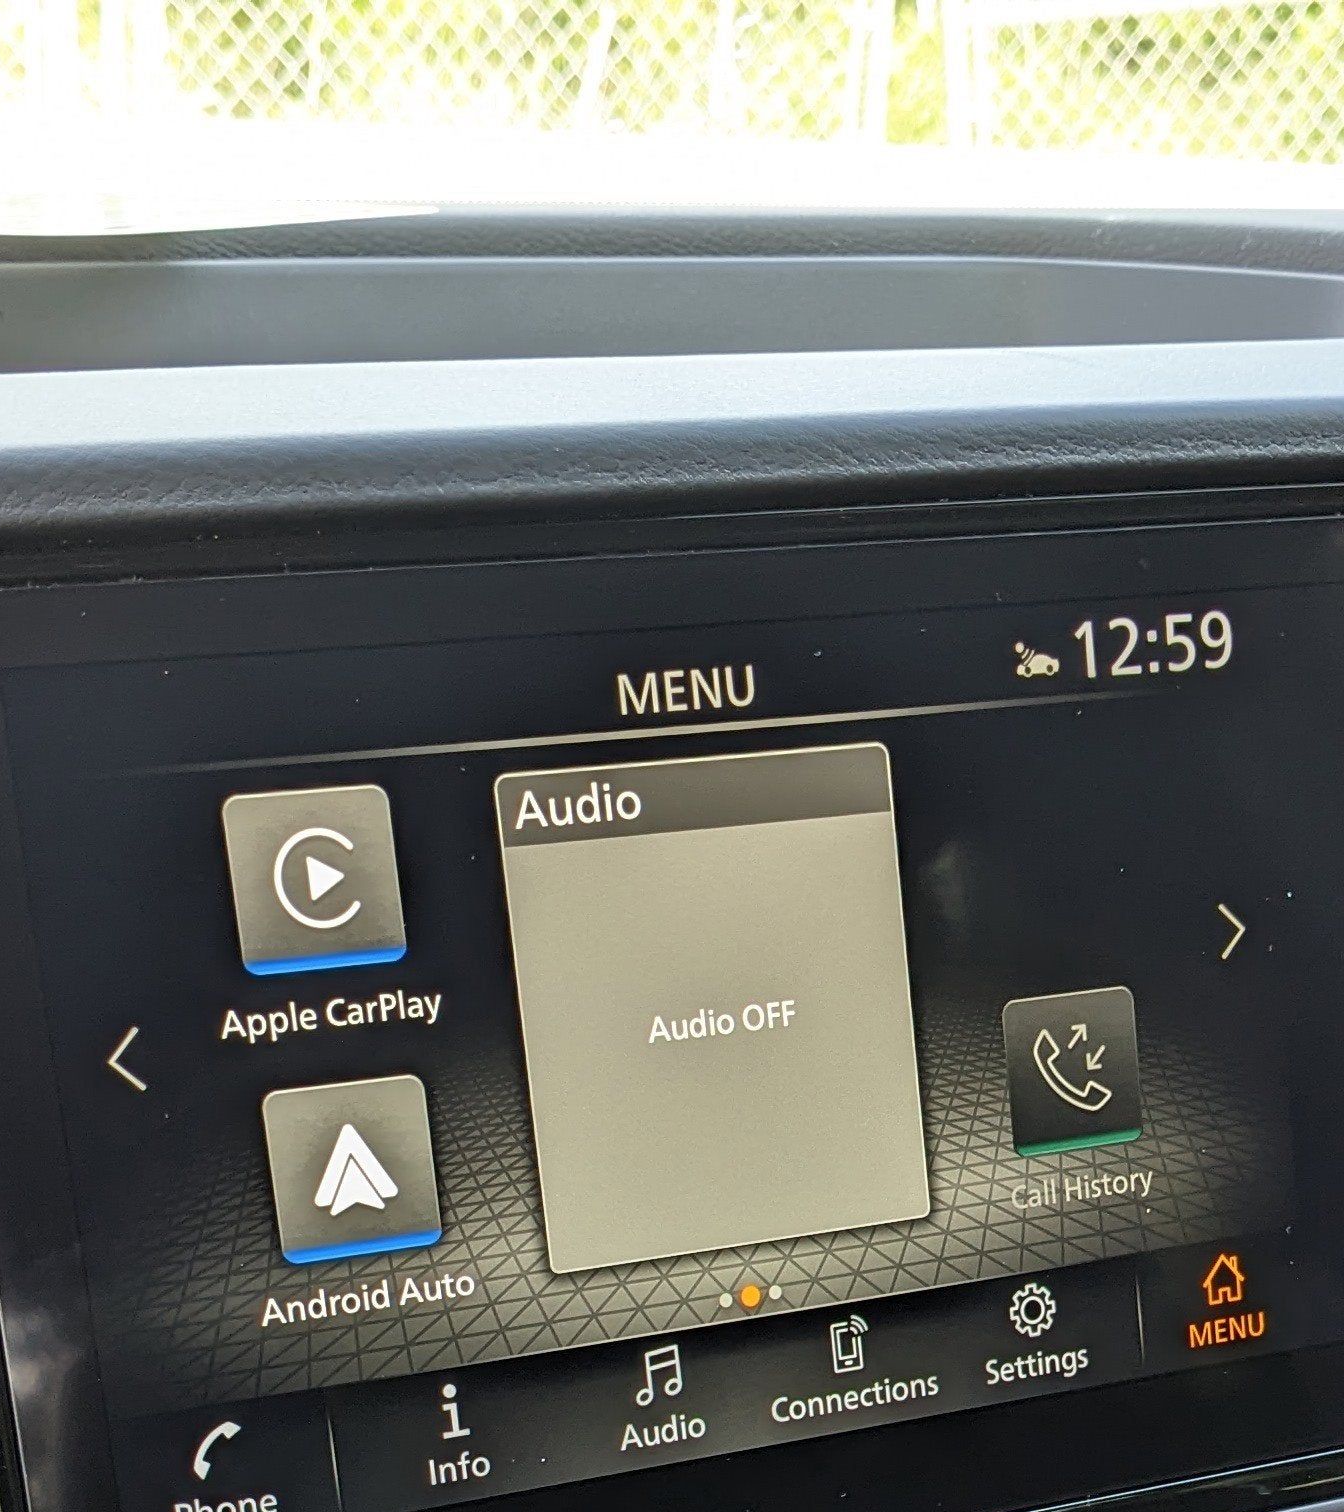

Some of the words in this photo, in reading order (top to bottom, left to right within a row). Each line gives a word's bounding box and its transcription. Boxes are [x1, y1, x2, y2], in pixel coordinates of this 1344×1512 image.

[1073, 609, 1235, 680] 12:59
[616, 665, 756, 716] MENU
[514, 780, 644, 831] Audio
[219, 1001, 319, 1046] Apple
[325, 989, 443, 1029] CarPlay
[647, 1008, 736, 1044] Audio
[742, 999, 798, 1033] OFF
[1010, 1177, 1059, 1211] Call
[1064, 1167, 1155, 1205] History
[260, 1281, 393, 1327] Android
[399, 1272, 477, 1307] Auto
[1188, 1309, 1267, 1350] MENU
[984, 1343, 1090, 1388] Settings
[769, 1372, 940, 1424] Connections
[619, 1413, 708, 1452] Audio
[428, 1449, 492, 1487] Info
